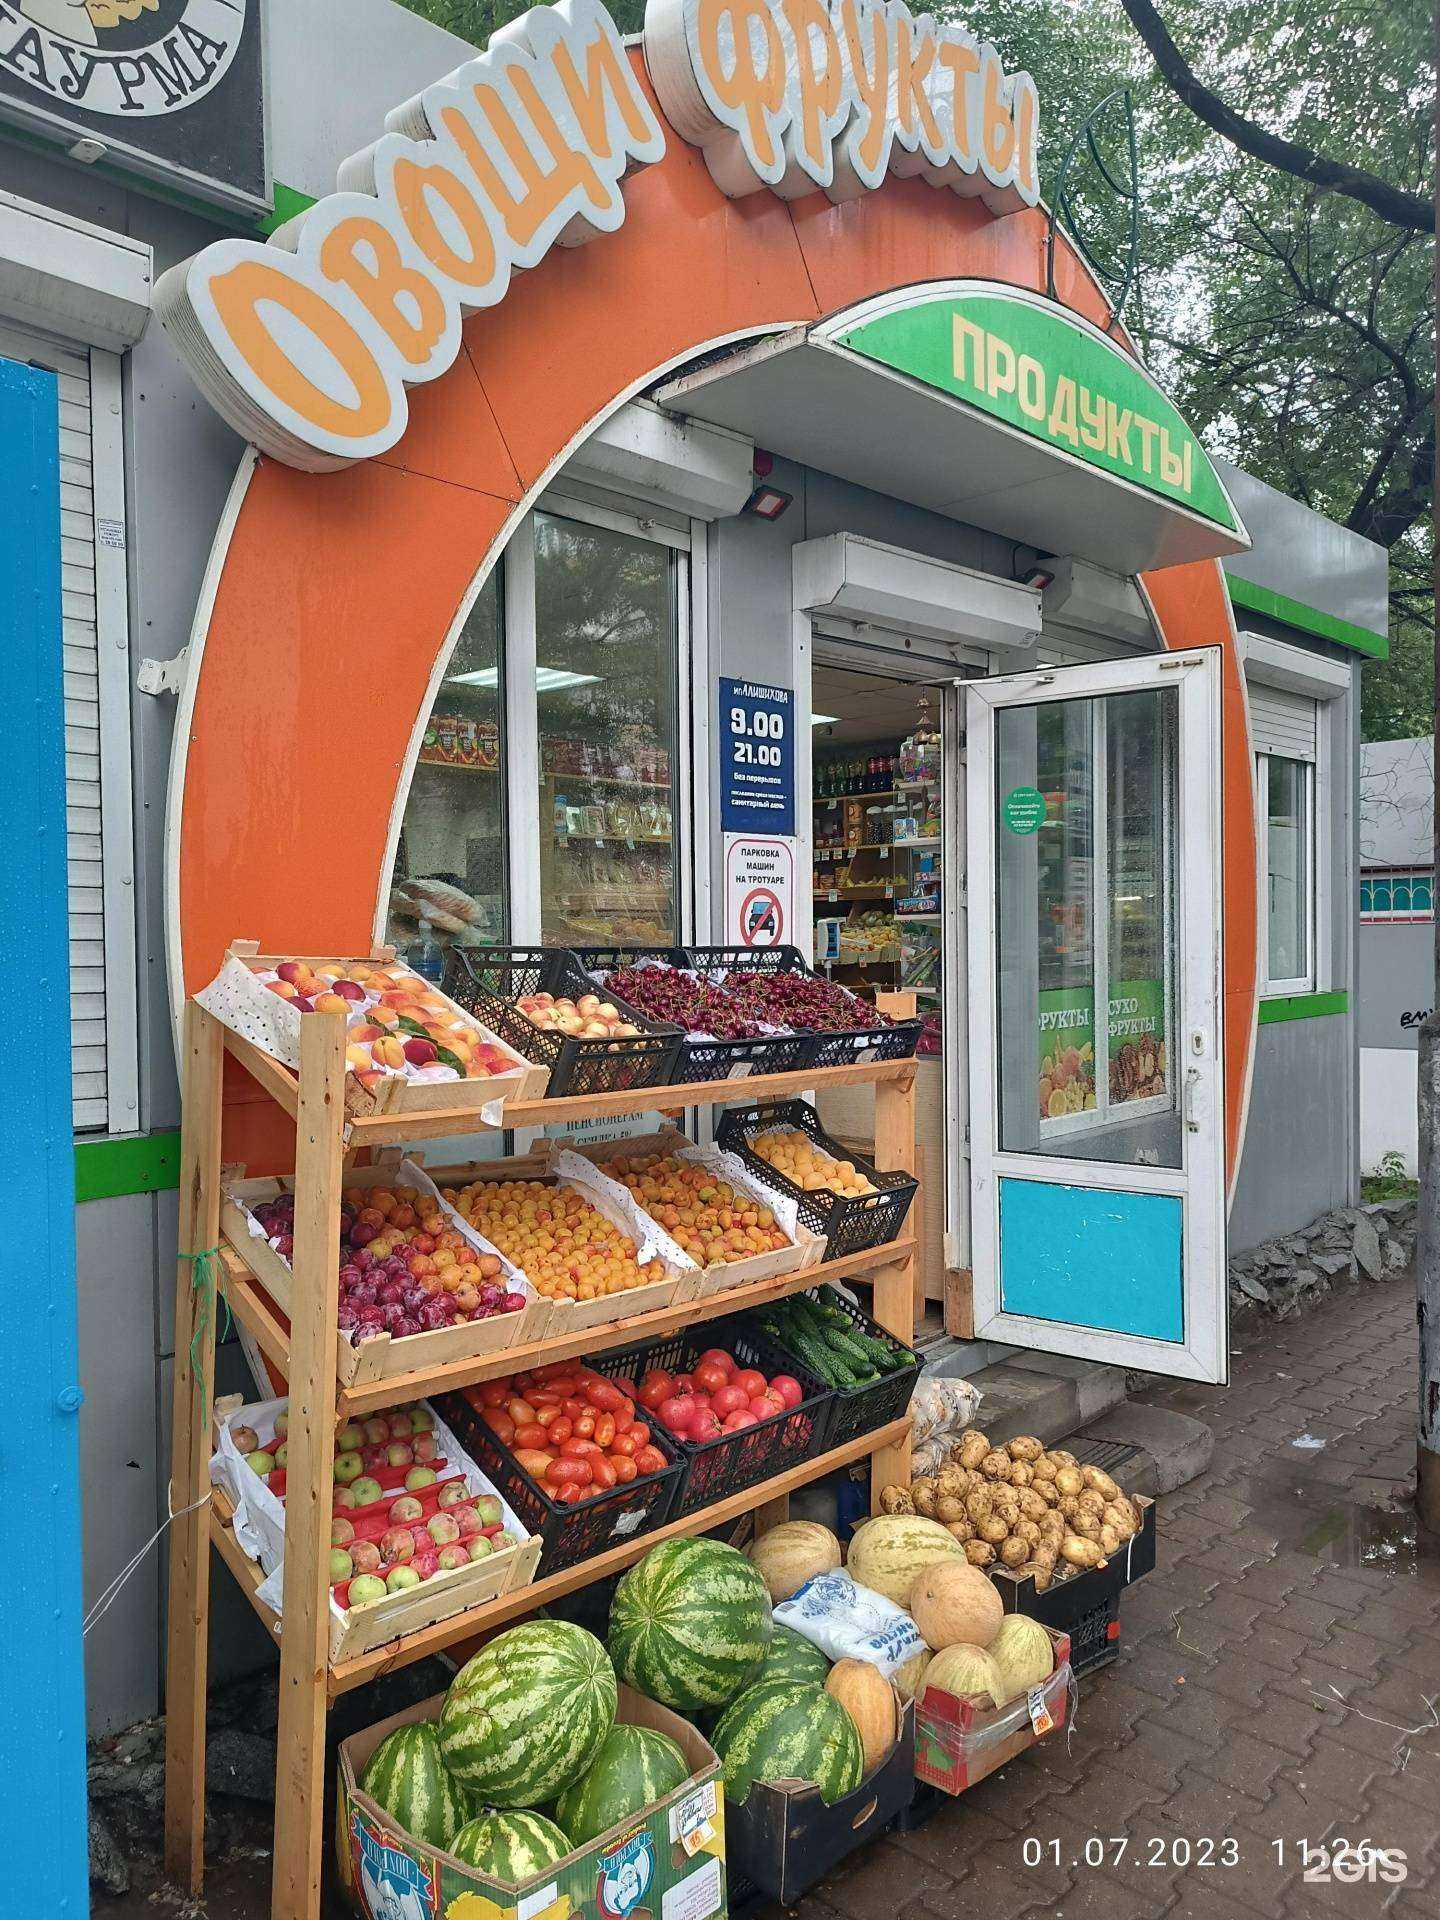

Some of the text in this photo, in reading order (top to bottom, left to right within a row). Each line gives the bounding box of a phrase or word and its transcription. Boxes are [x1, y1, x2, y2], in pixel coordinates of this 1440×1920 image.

[0, 4, 228, 110] АУРМА
[697, 0, 1036, 183] ФРУКТЫ
[208, 20, 654, 438] ОВОЩИ
[951, 312, 1194, 495] ПРОДУКТЫ
[731, 707, 784, 740] 9.00
[733, 741, 782, 767] 21.00
[741, 848, 780, 858] ПАРКОВКА
[746, 862, 775, 871] МАШИН
[735, 875, 785, 885] НА ТРОТУАРЕ
[1108, 998, 1139, 1016] СУХО
[1039, 1008, 1090, 1031] РУКТЫ
[1108, 1016, 1156, 1037] ФРУКТЫ
